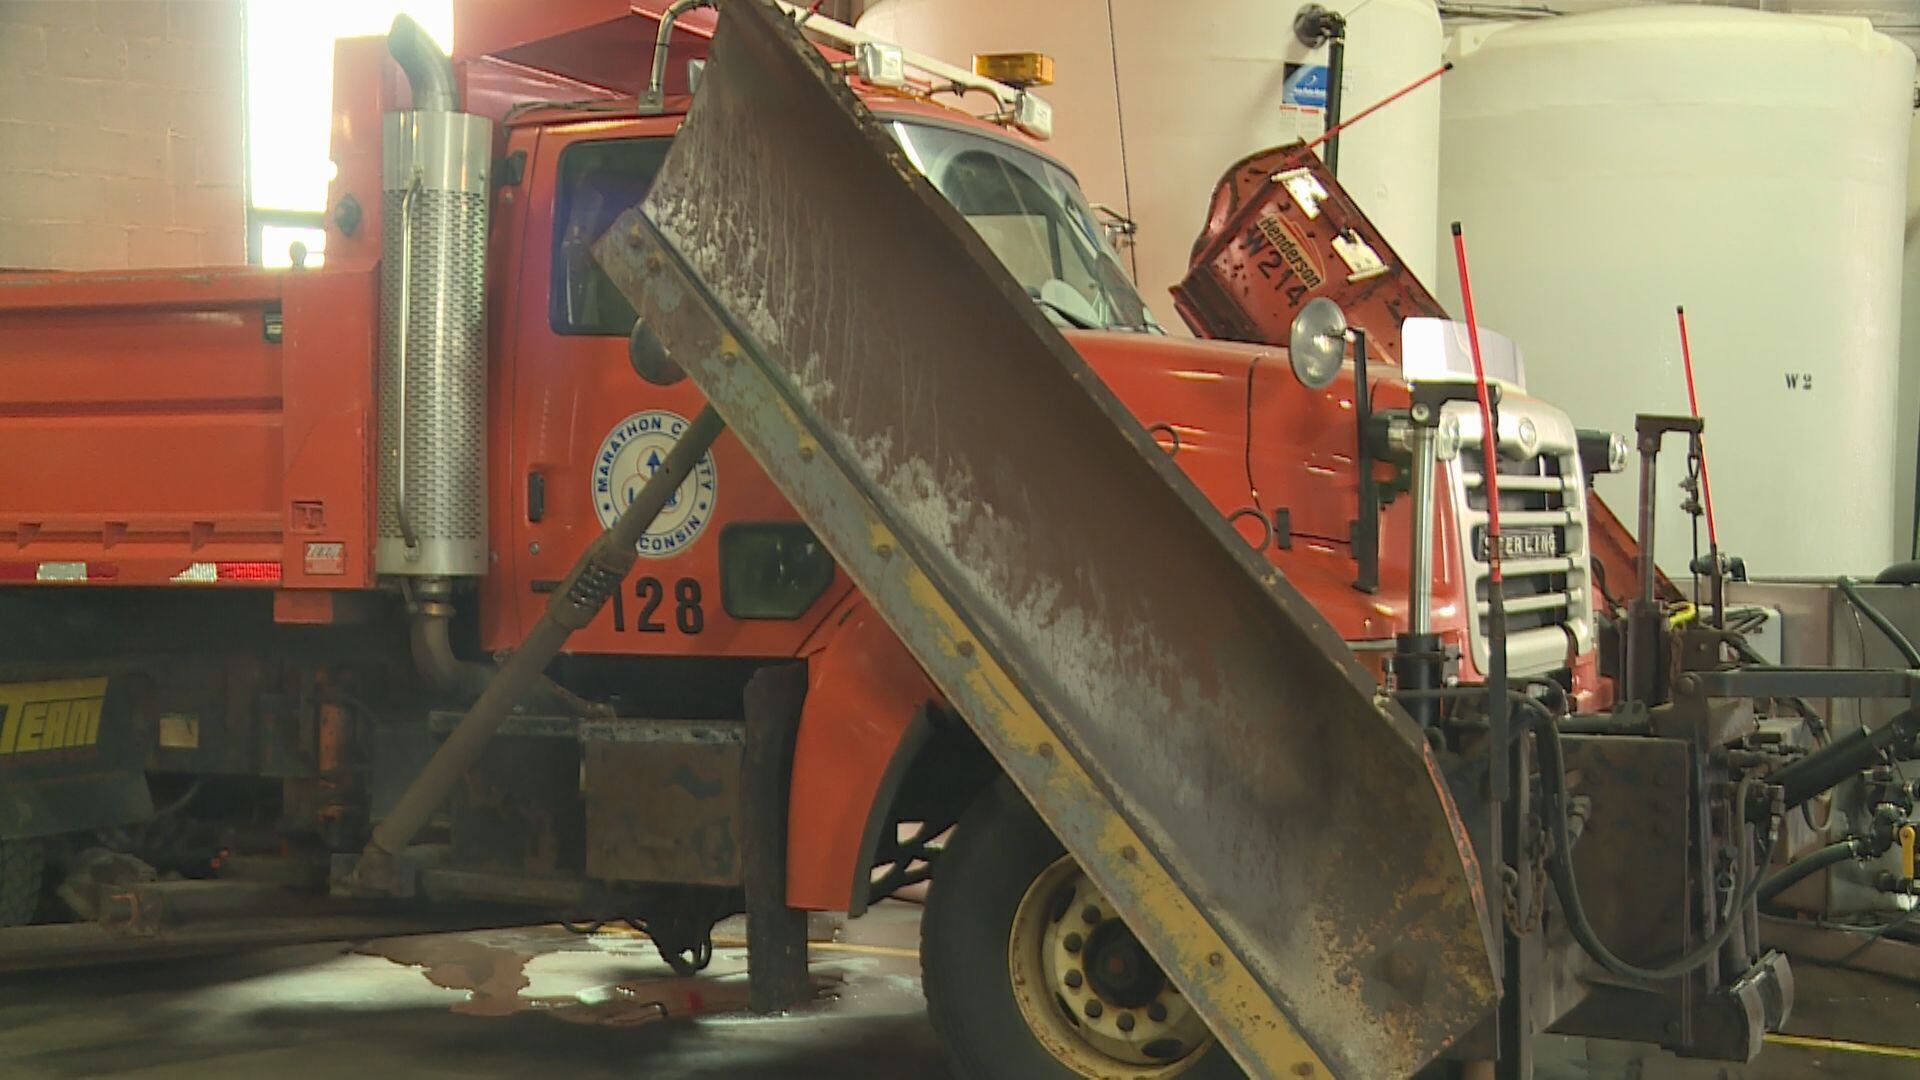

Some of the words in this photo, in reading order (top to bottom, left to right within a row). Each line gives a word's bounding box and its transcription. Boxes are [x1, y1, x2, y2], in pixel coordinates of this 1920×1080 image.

[1240, 222, 1308, 308] W214
[1260, 216, 1321, 288] Henderson
[598, 416, 662, 493] MARATHON
[611, 576, 704, 635] 128
